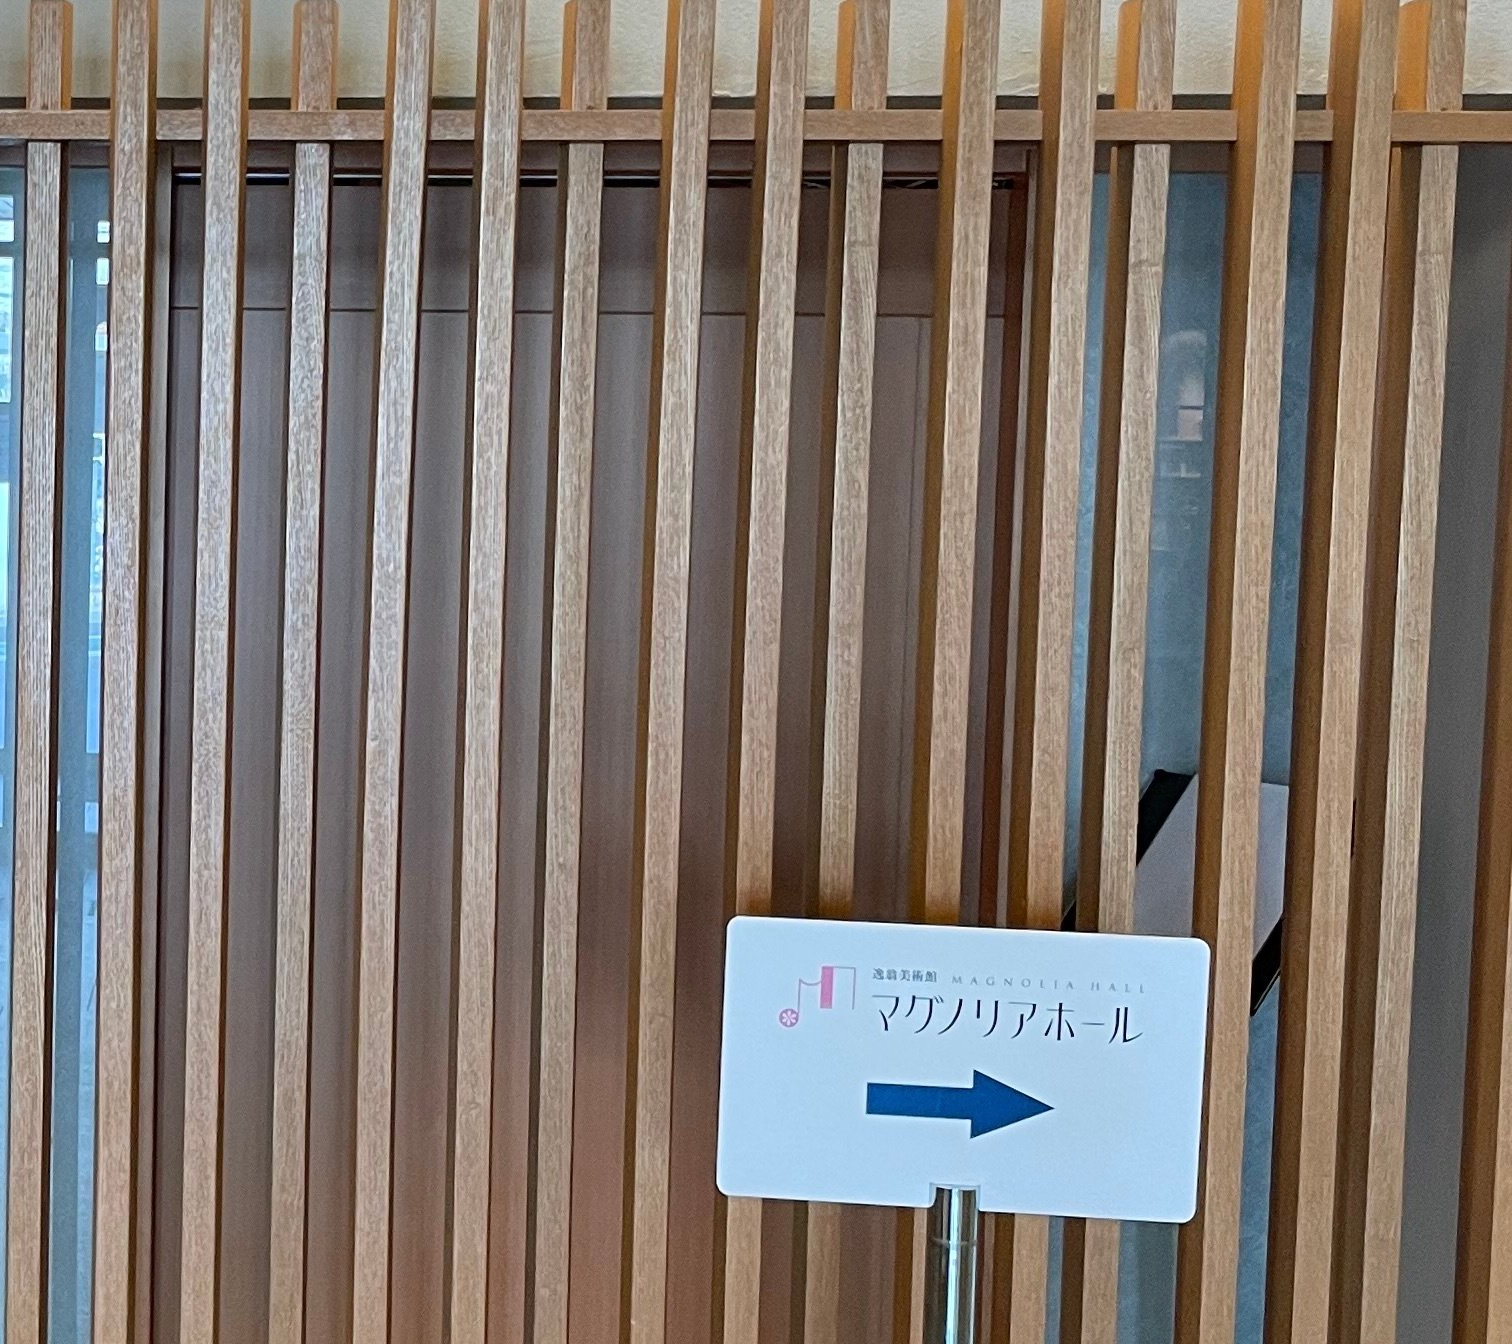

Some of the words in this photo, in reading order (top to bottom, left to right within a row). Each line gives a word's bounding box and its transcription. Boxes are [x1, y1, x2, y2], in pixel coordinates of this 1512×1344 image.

[951, 975, 1075, 990] MAGNOLIA
[1090, 981, 1145, 994] HALL
[872, 994, 1144, 1044] マグノリアホール
